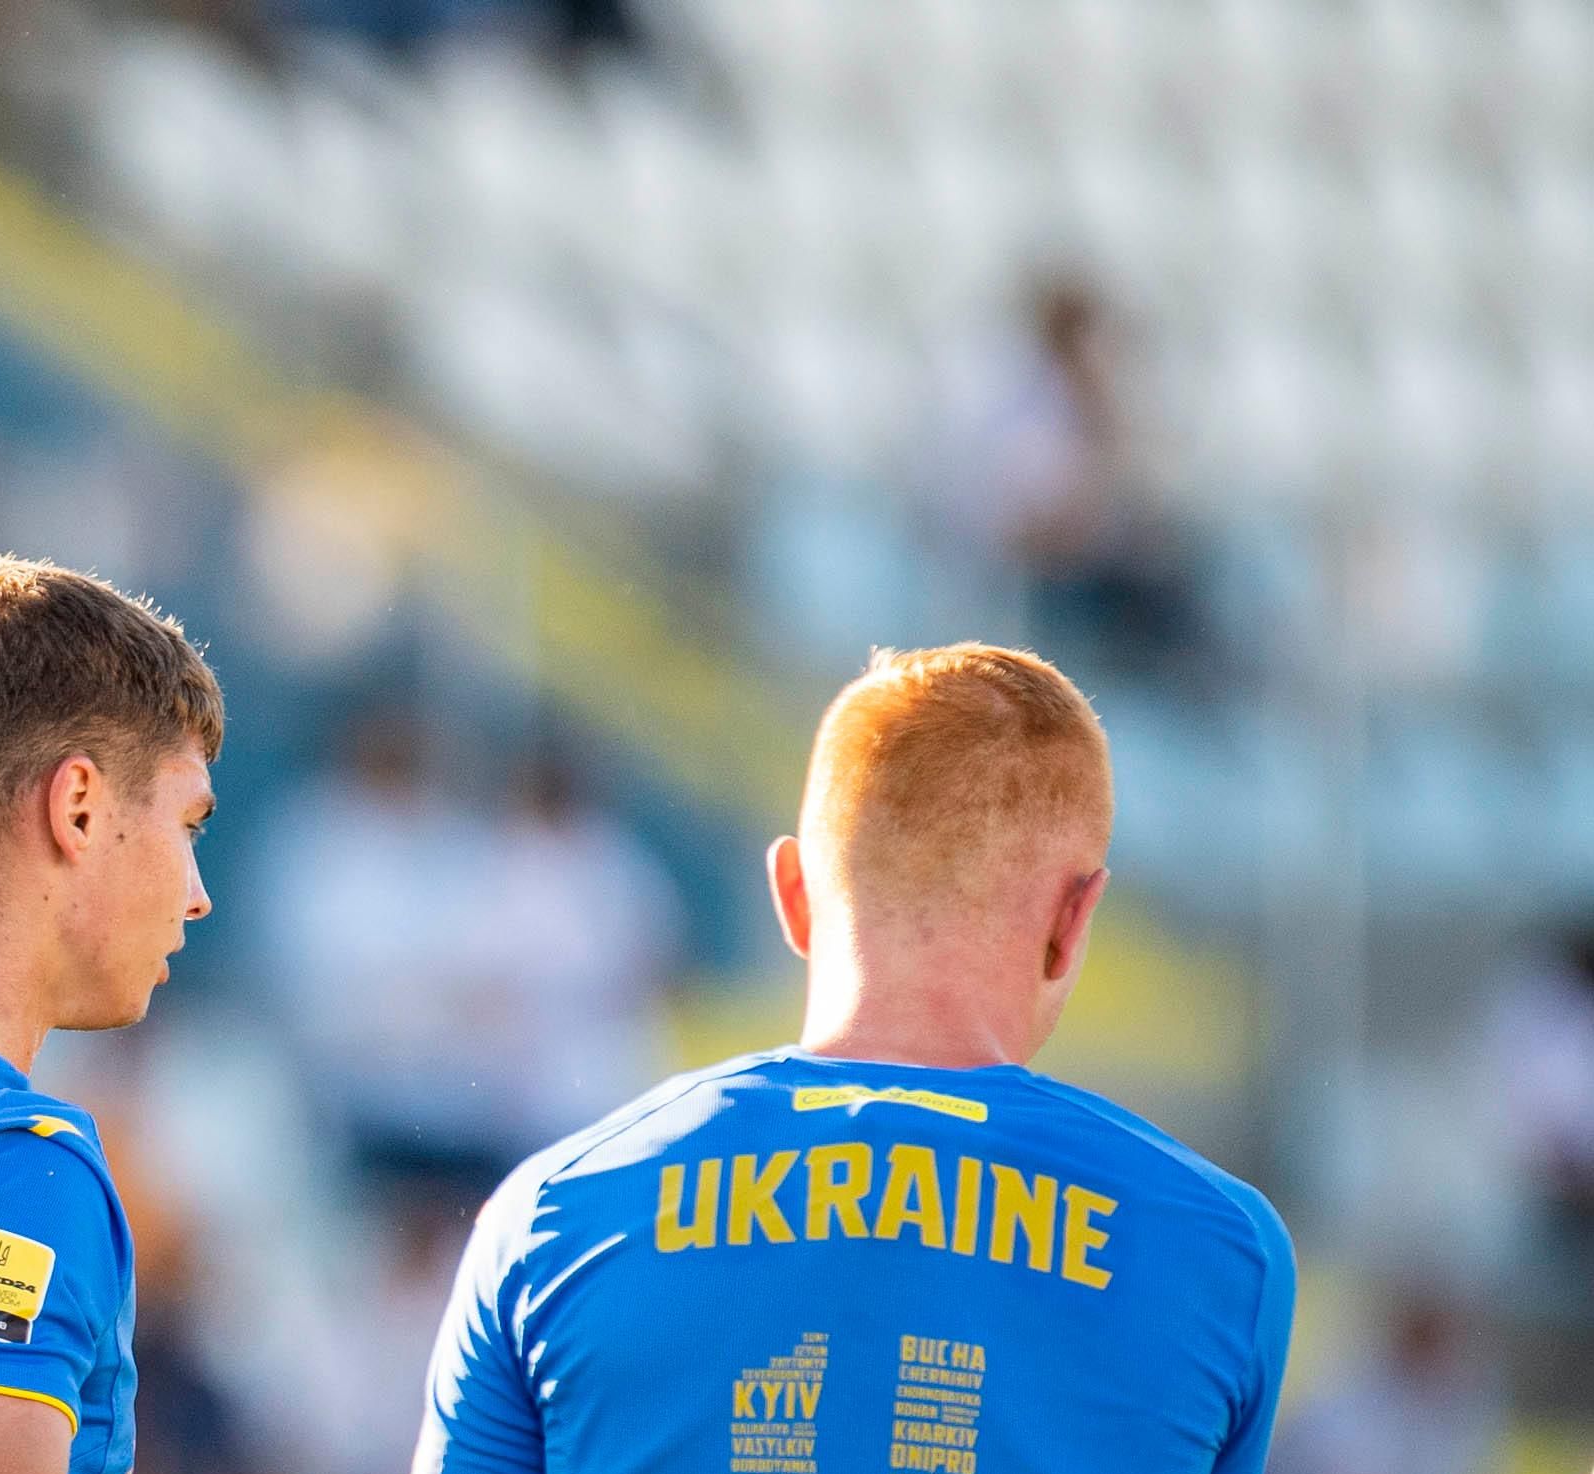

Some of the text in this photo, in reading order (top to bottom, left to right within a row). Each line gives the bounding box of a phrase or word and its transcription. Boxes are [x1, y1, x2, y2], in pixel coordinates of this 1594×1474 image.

[654, 1141, 1118, 1290] UKRAINE
[901, 1334, 986, 1372] BUCHA
[899, 1363, 983, 1390] CHERNIHIV
[733, 1380, 823, 1420] KYIV
[733, 1438, 815, 1456] VASYLKIV
[893, 1420, 979, 1448] KHARKIV
